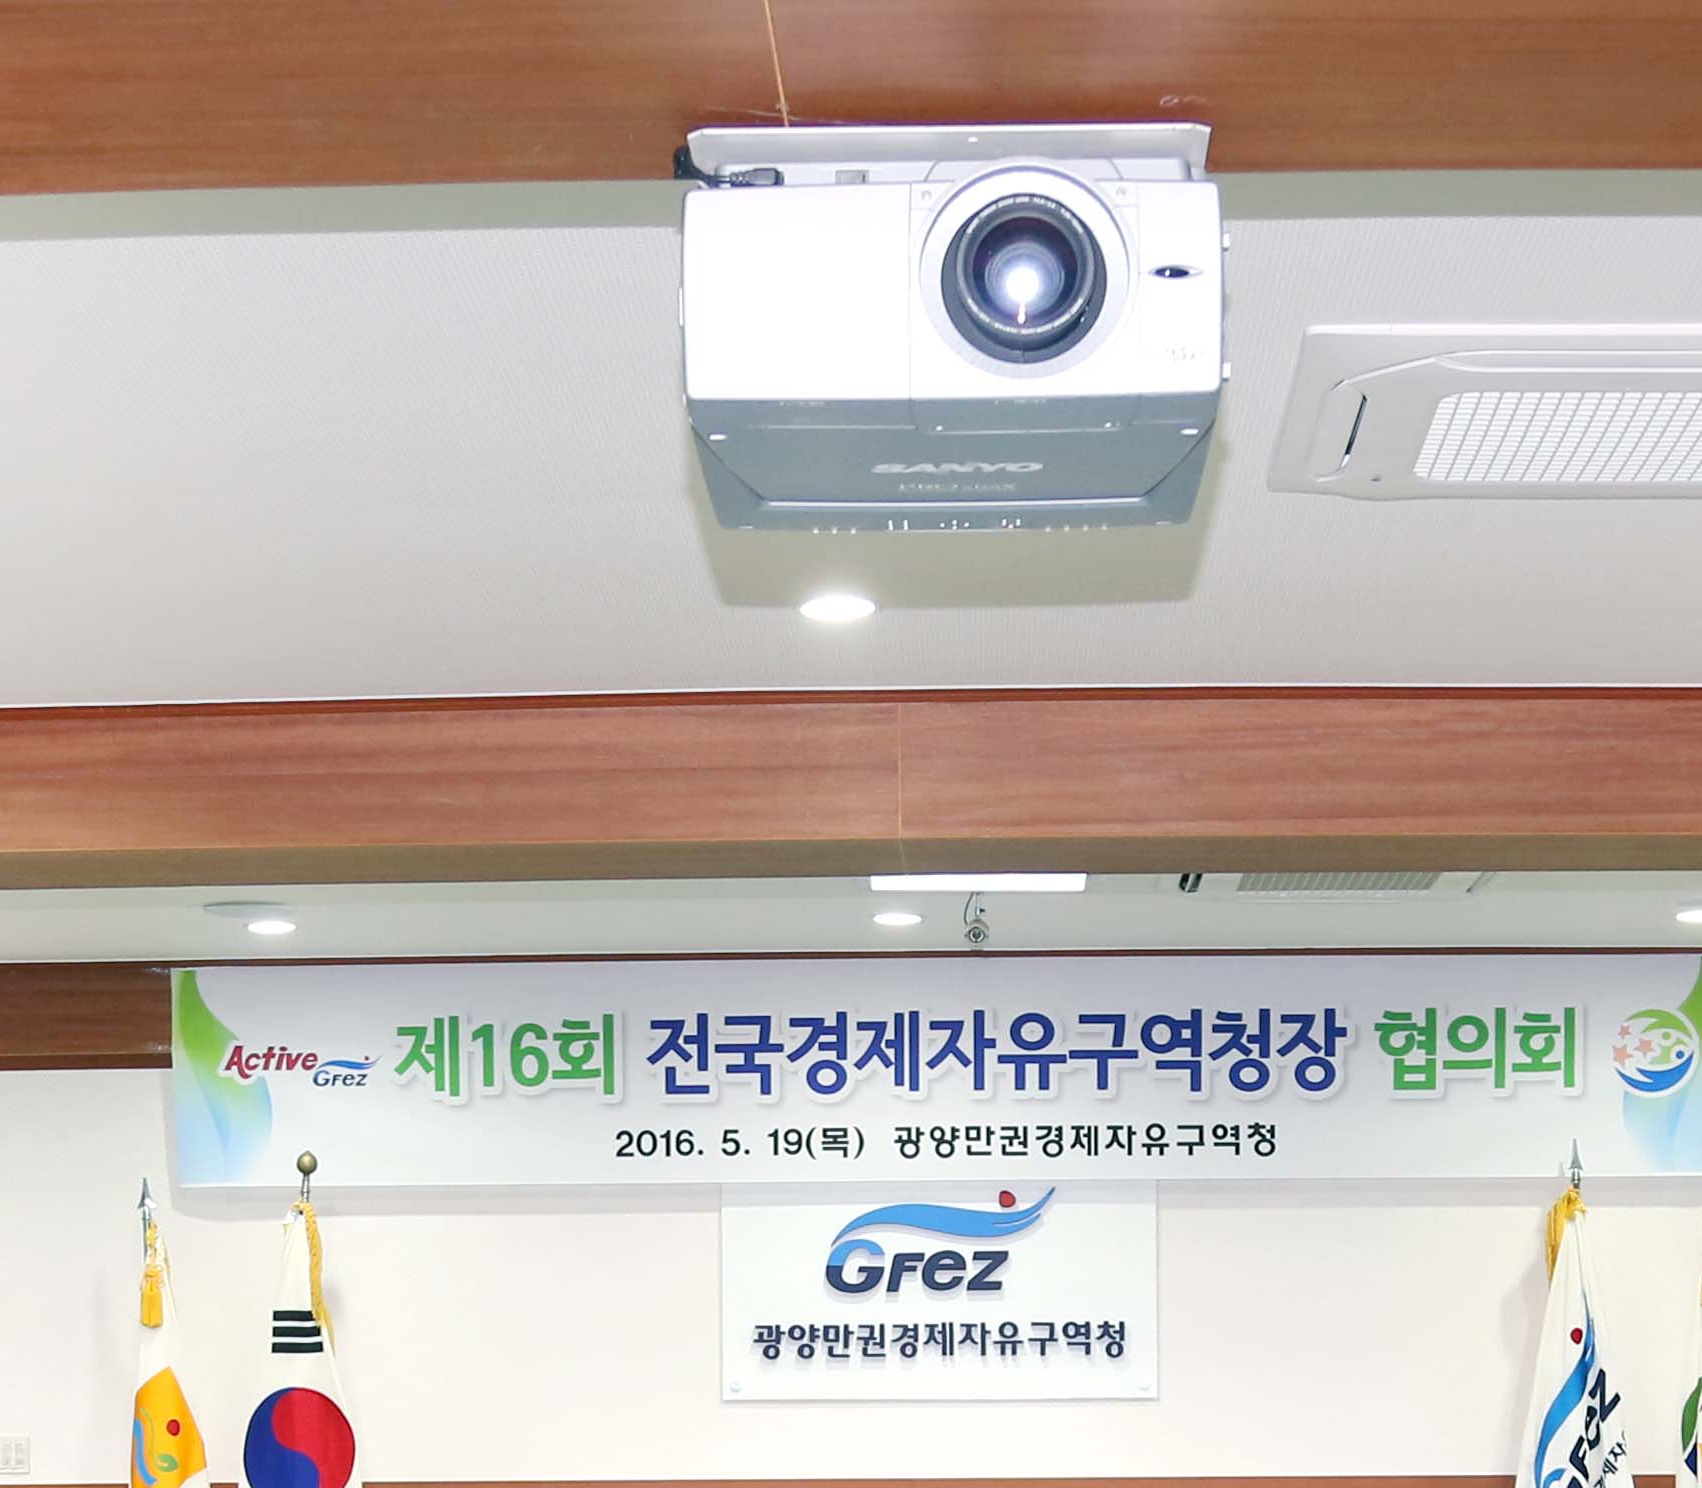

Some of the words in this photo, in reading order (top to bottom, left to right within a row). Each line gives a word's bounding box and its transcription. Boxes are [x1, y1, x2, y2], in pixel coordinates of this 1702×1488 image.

[871, 461, 1044, 474] SANYO
[224, 1043, 320, 1079] Active
[395, 1012, 616, 1098] 제16회
[647, 1007, 1348, 1097] 전국경제자유구역청장
[1374, 1005, 1578, 1092] 협의회
[614, 1128, 704, 1159] 2016.
[720, 1129, 751, 1158] 5.
[767, 1126, 866, 1161] 19(목)
[893, 1122, 1279, 1159] 광양만권경제자유구역청
[752, 1320, 1127, 1360] 광양만권경제자유구역청
